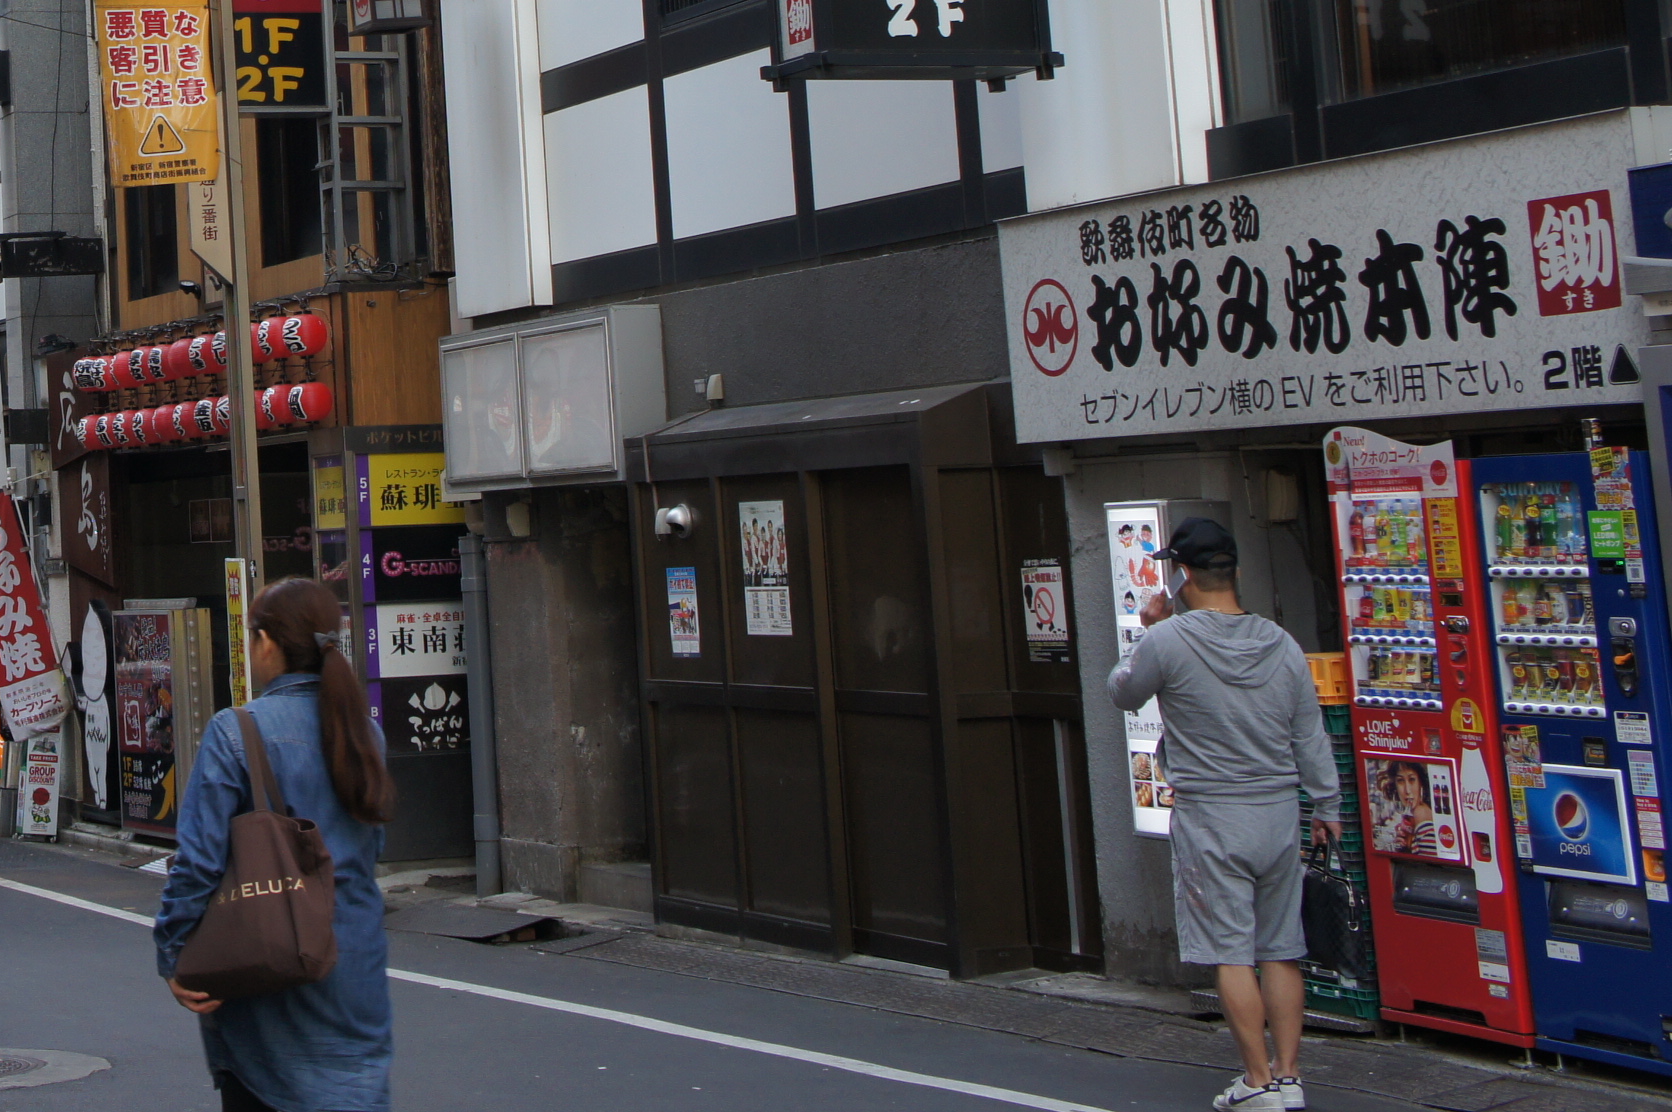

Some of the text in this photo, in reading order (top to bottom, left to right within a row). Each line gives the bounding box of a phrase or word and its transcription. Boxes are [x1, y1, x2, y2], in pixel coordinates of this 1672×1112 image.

[105, 9, 200, 41] 悪質な
[234, 16, 300, 54] 1F
[108, 43, 201, 76] 客引き
[111, 77, 208, 110] に注意
[237, 66, 305, 102] 2F
[1077, 195, 1261, 266] 歌舞伎町名物
[1533, 199, 1614, 293] 鋤
[1085, 214, 1518, 373] お好み焼本陣
[1562, 289, 1595, 310] すき
[1542, 346, 1606, 392] 2階
[1343, 435, 1365, 447] New!
[1351, 448, 1420, 468] トクホのコーク!
[1585, 593, 1595, 625] BOSS
[408, 715, 462, 734] てっぱん
[1366, 720, 1392, 735] LOVE
[1368, 733, 1408, 750] Shinjuku
[29, 766, 56, 777] GROUP
[1559, 842, 1591, 858] pepsi
